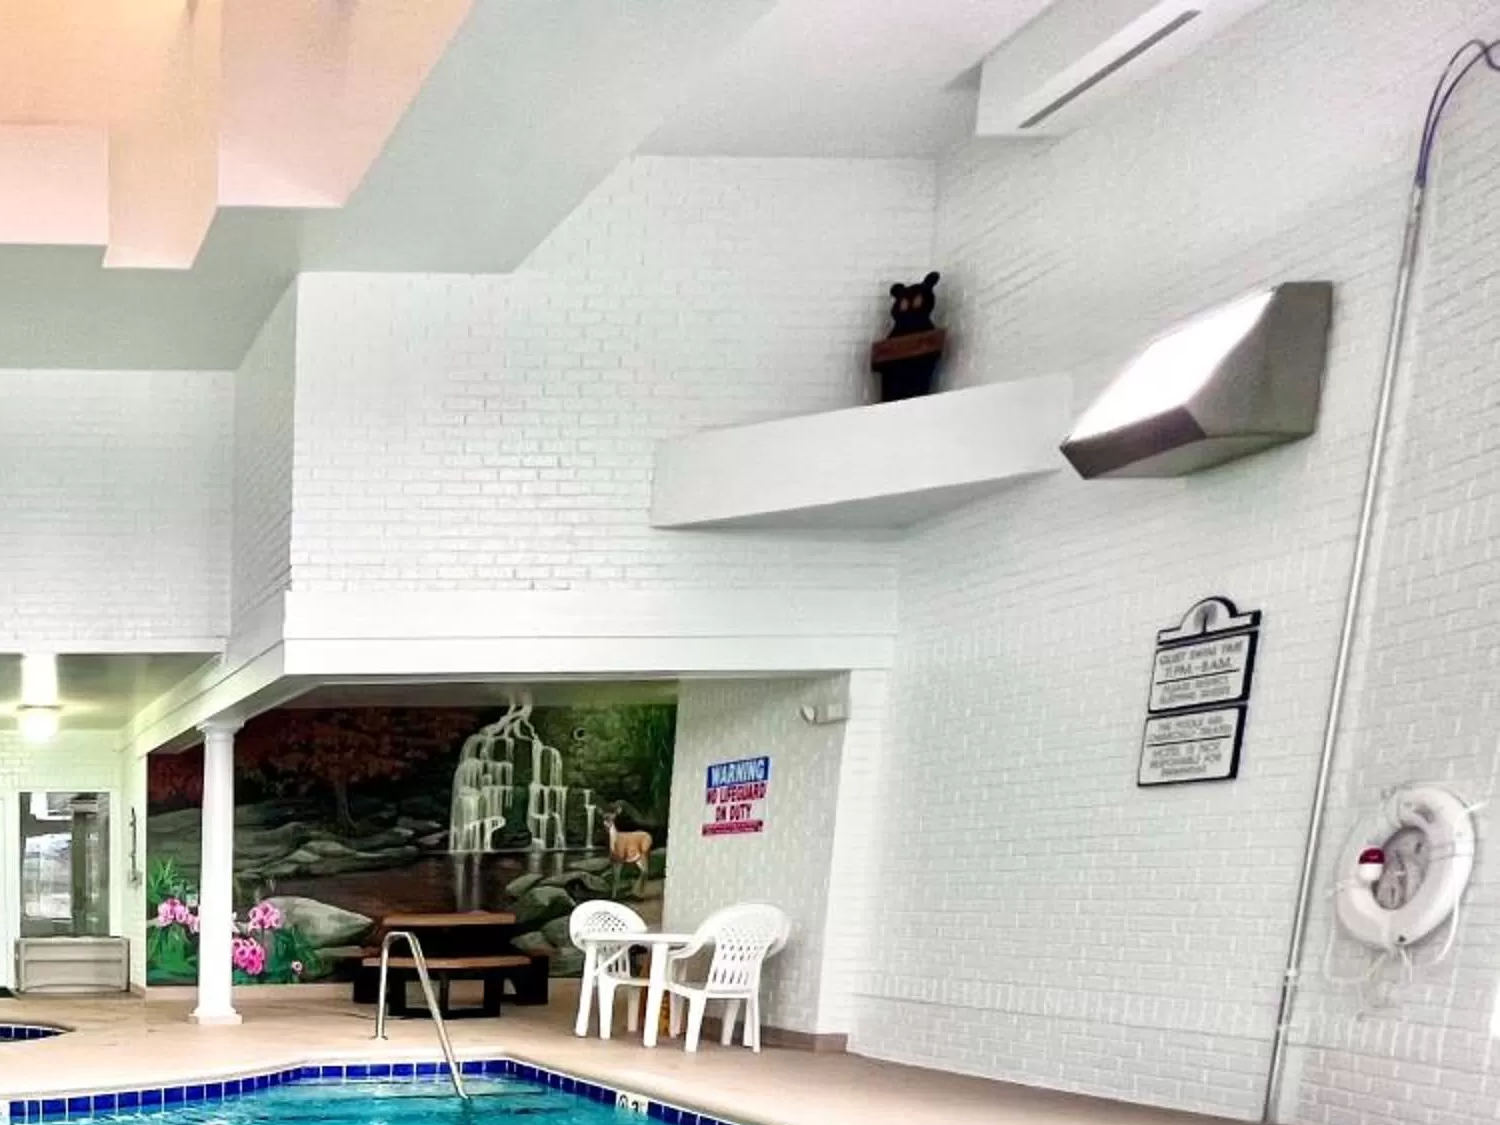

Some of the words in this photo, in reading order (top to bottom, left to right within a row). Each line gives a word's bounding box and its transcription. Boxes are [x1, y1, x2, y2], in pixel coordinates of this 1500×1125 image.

[711, 759, 765, 787] WARNING
[706, 788, 717, 804] NO
[719, 783, 766, 802] LIFEGUARD
[715, 805, 727, 822] ON
[729, 803, 753, 820] DUTY
